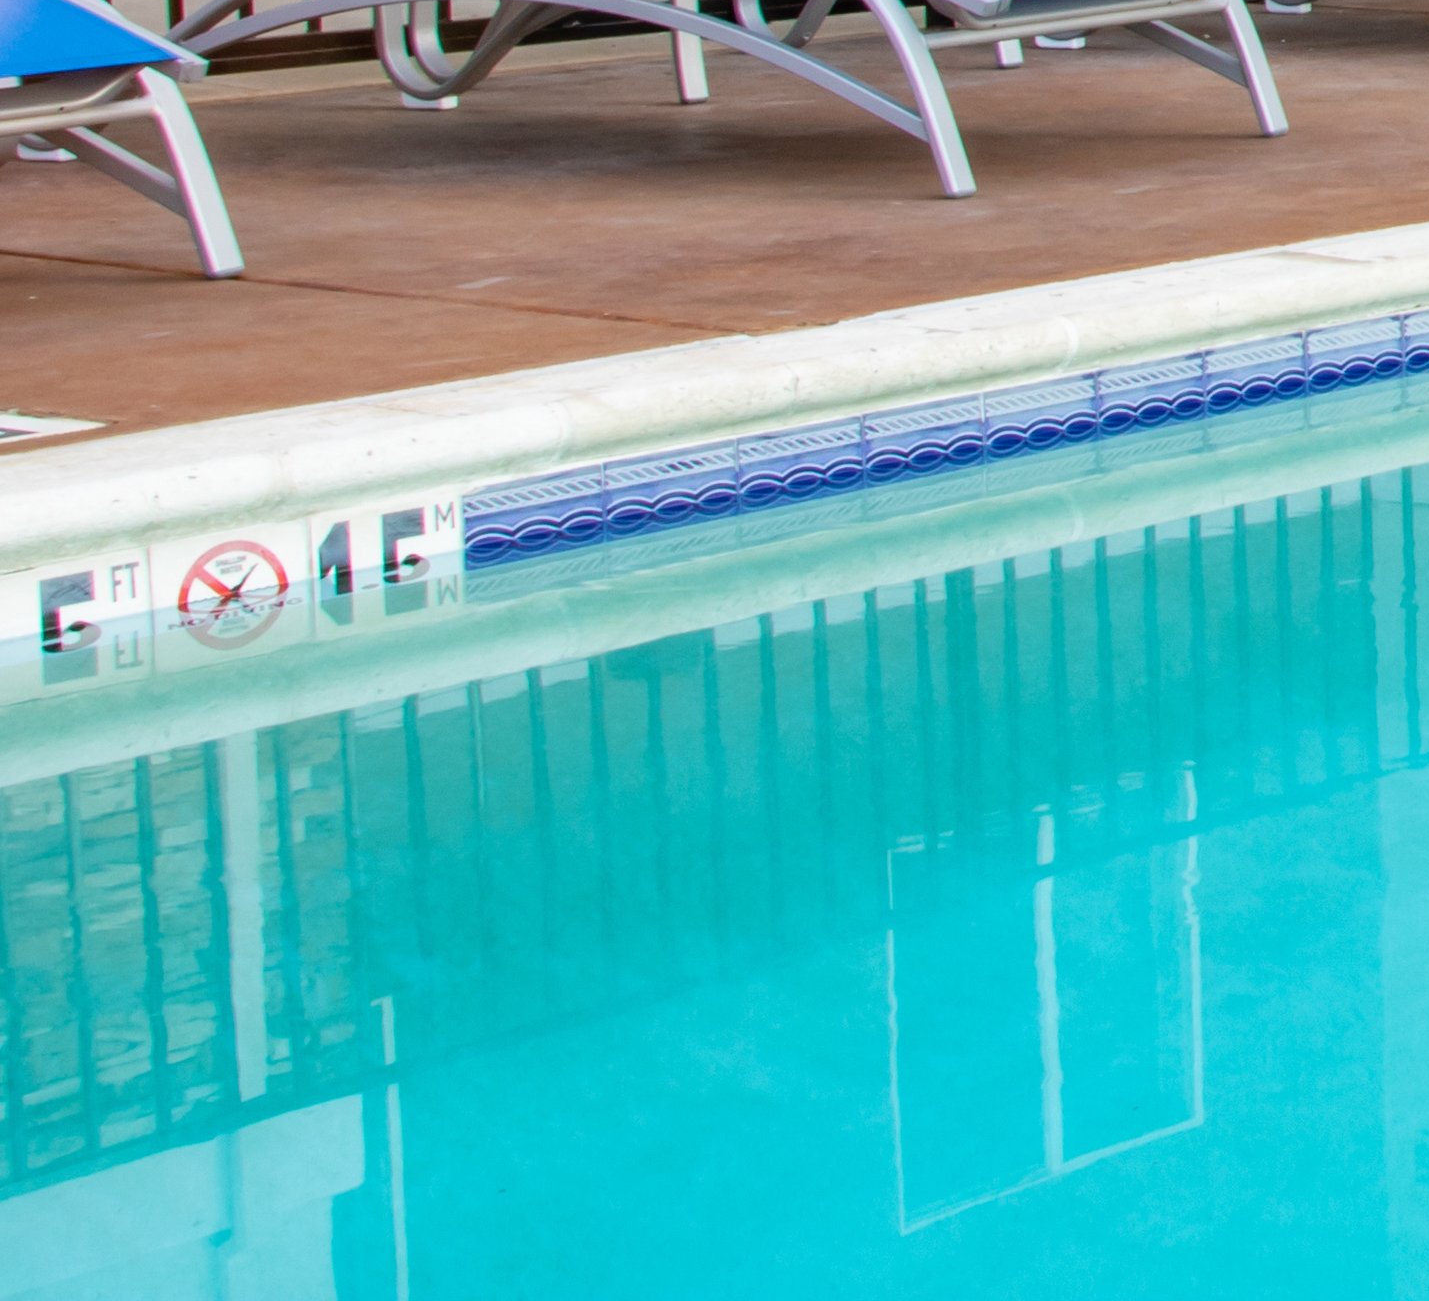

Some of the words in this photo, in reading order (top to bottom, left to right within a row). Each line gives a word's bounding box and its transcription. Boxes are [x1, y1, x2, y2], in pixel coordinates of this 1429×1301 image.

[40, 569, 101, 654] 5
[111, 561, 140, 603] FT
[434, 502, 456, 532] M
